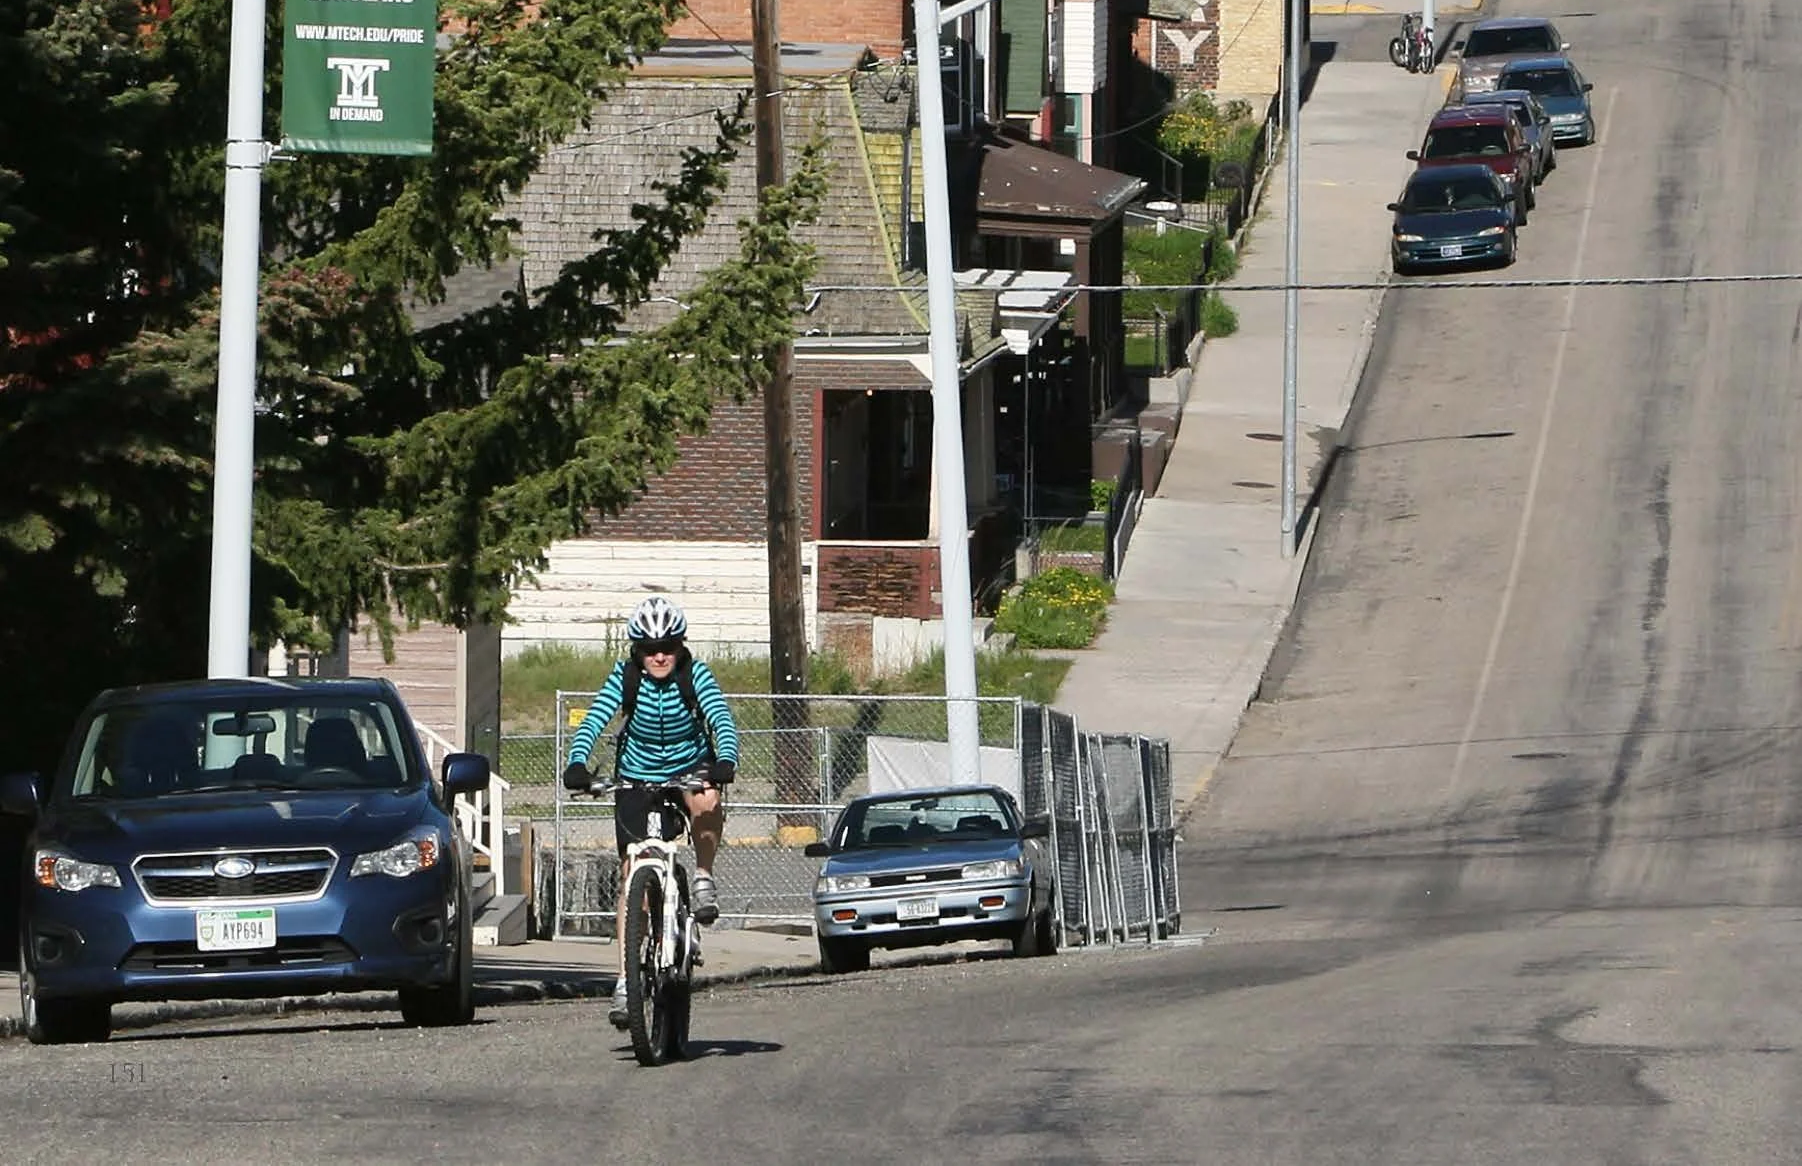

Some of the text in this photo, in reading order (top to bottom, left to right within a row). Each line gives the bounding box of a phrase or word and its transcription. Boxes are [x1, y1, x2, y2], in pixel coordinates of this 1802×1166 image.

[295, 24, 425, 43] WWW.MTECH.EDU/PRIDE
[329, 107, 384, 122] IN DEMAND
